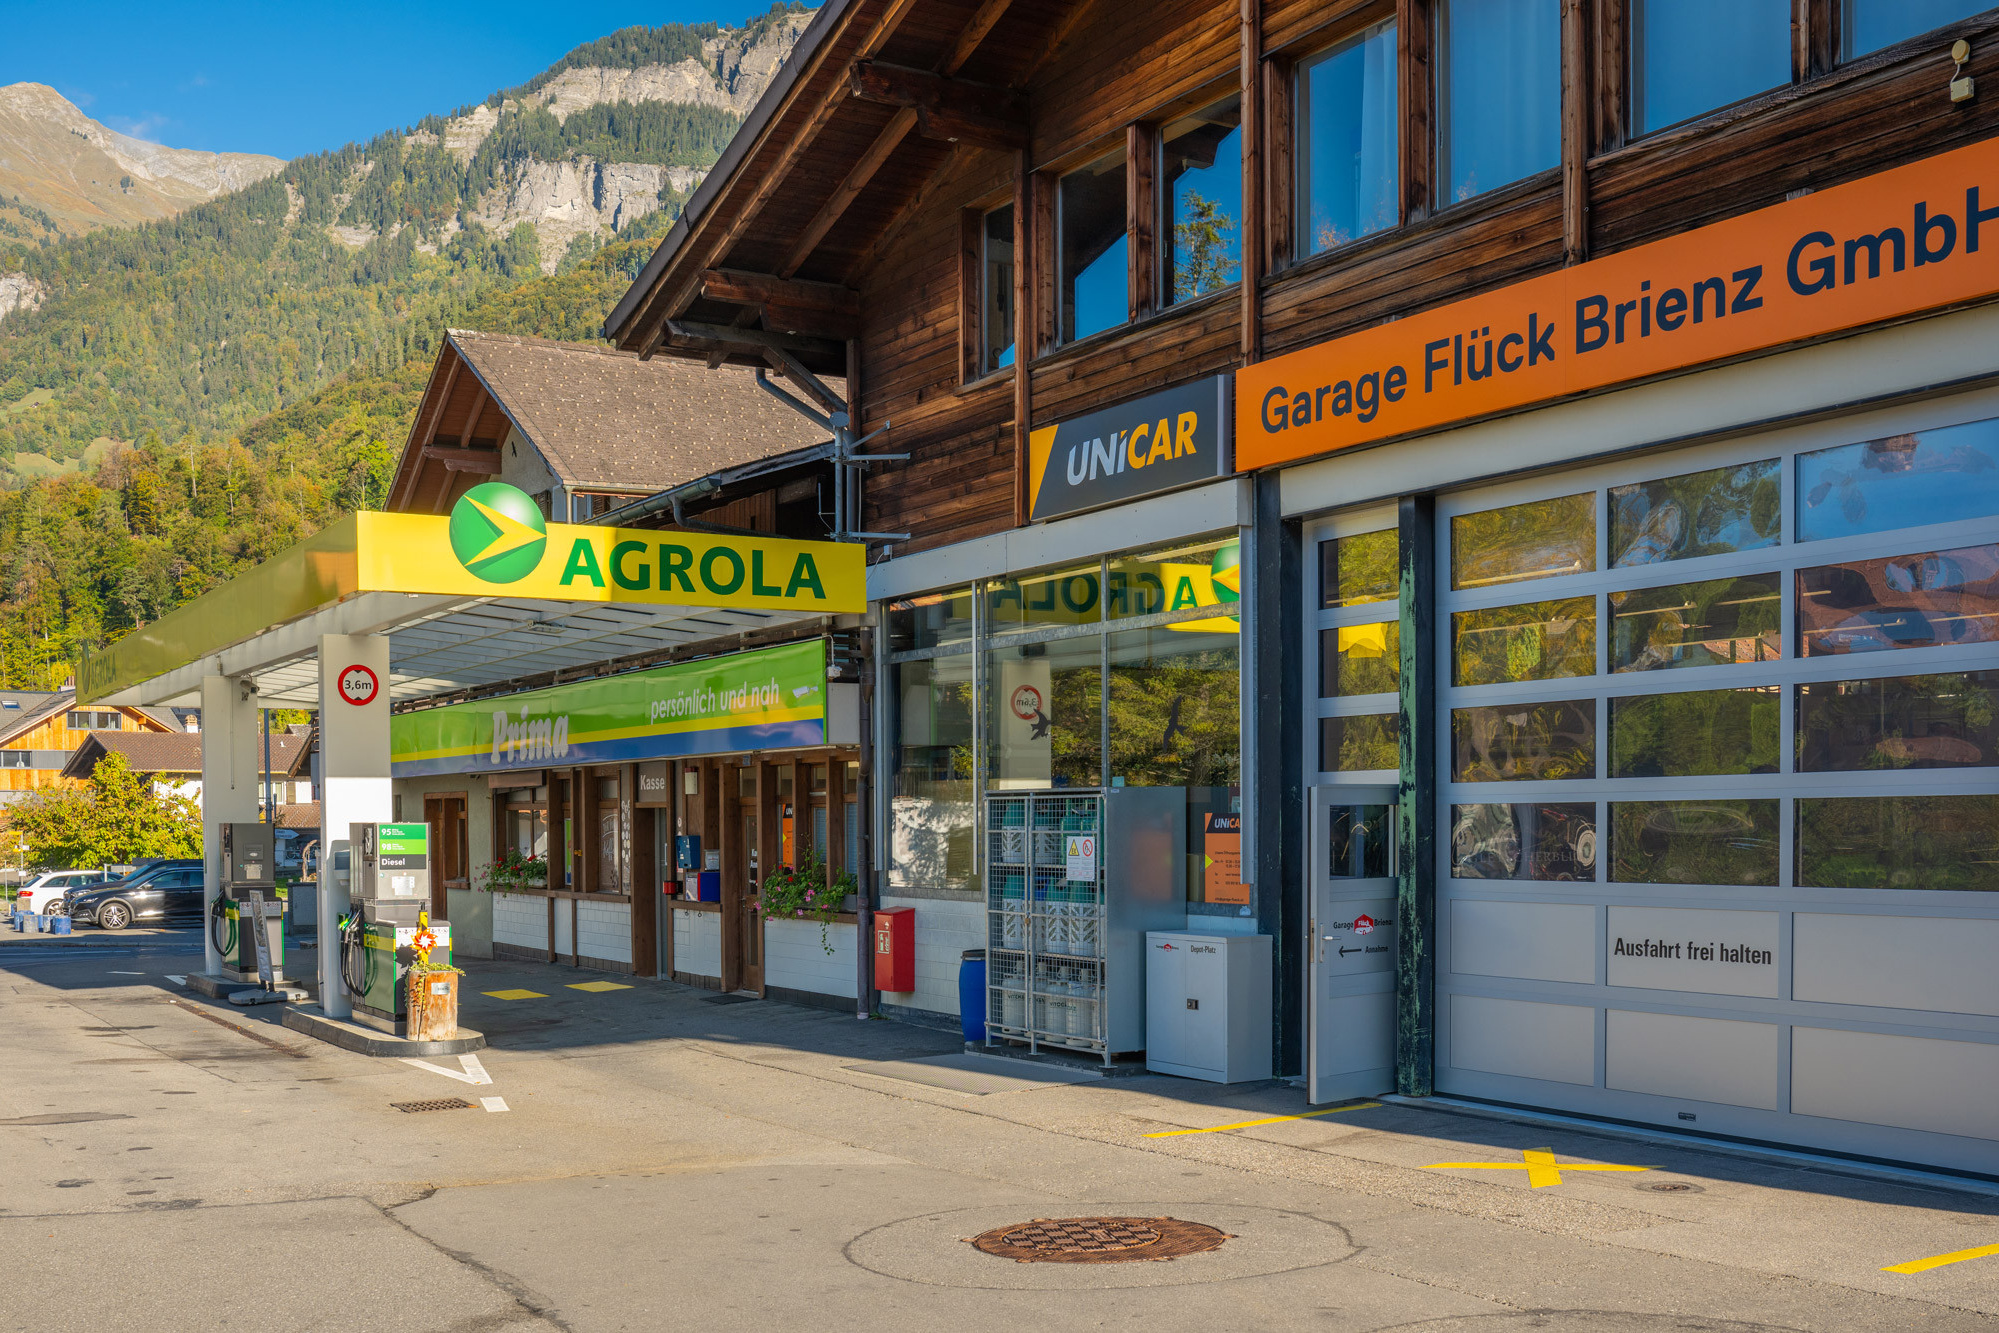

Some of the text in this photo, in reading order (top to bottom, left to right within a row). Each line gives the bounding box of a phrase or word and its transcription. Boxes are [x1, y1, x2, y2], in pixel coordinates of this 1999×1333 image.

[1261, 364, 1408, 434] Garage
[1424, 311, 1556, 394] Flück
[1575, 264, 1764, 355] Brienz
[558, 537, 827, 600] AGROLA
[344, 679, 372, 691] 3,6m
[651, 677, 780, 725] persönlich und nah
[490, 704, 569, 765] Prima
[640, 774, 665, 790] Kasse
[381, 828, 392, 836] 95
[381, 843, 392, 851] 98
[381, 858, 406, 866] Diesel
[1333, 921, 1354, 930] Garage
[1190, 945, 1217, 954] Depot-Platz
[1614, 937, 1772, 965] Ausfahrt frei halten
